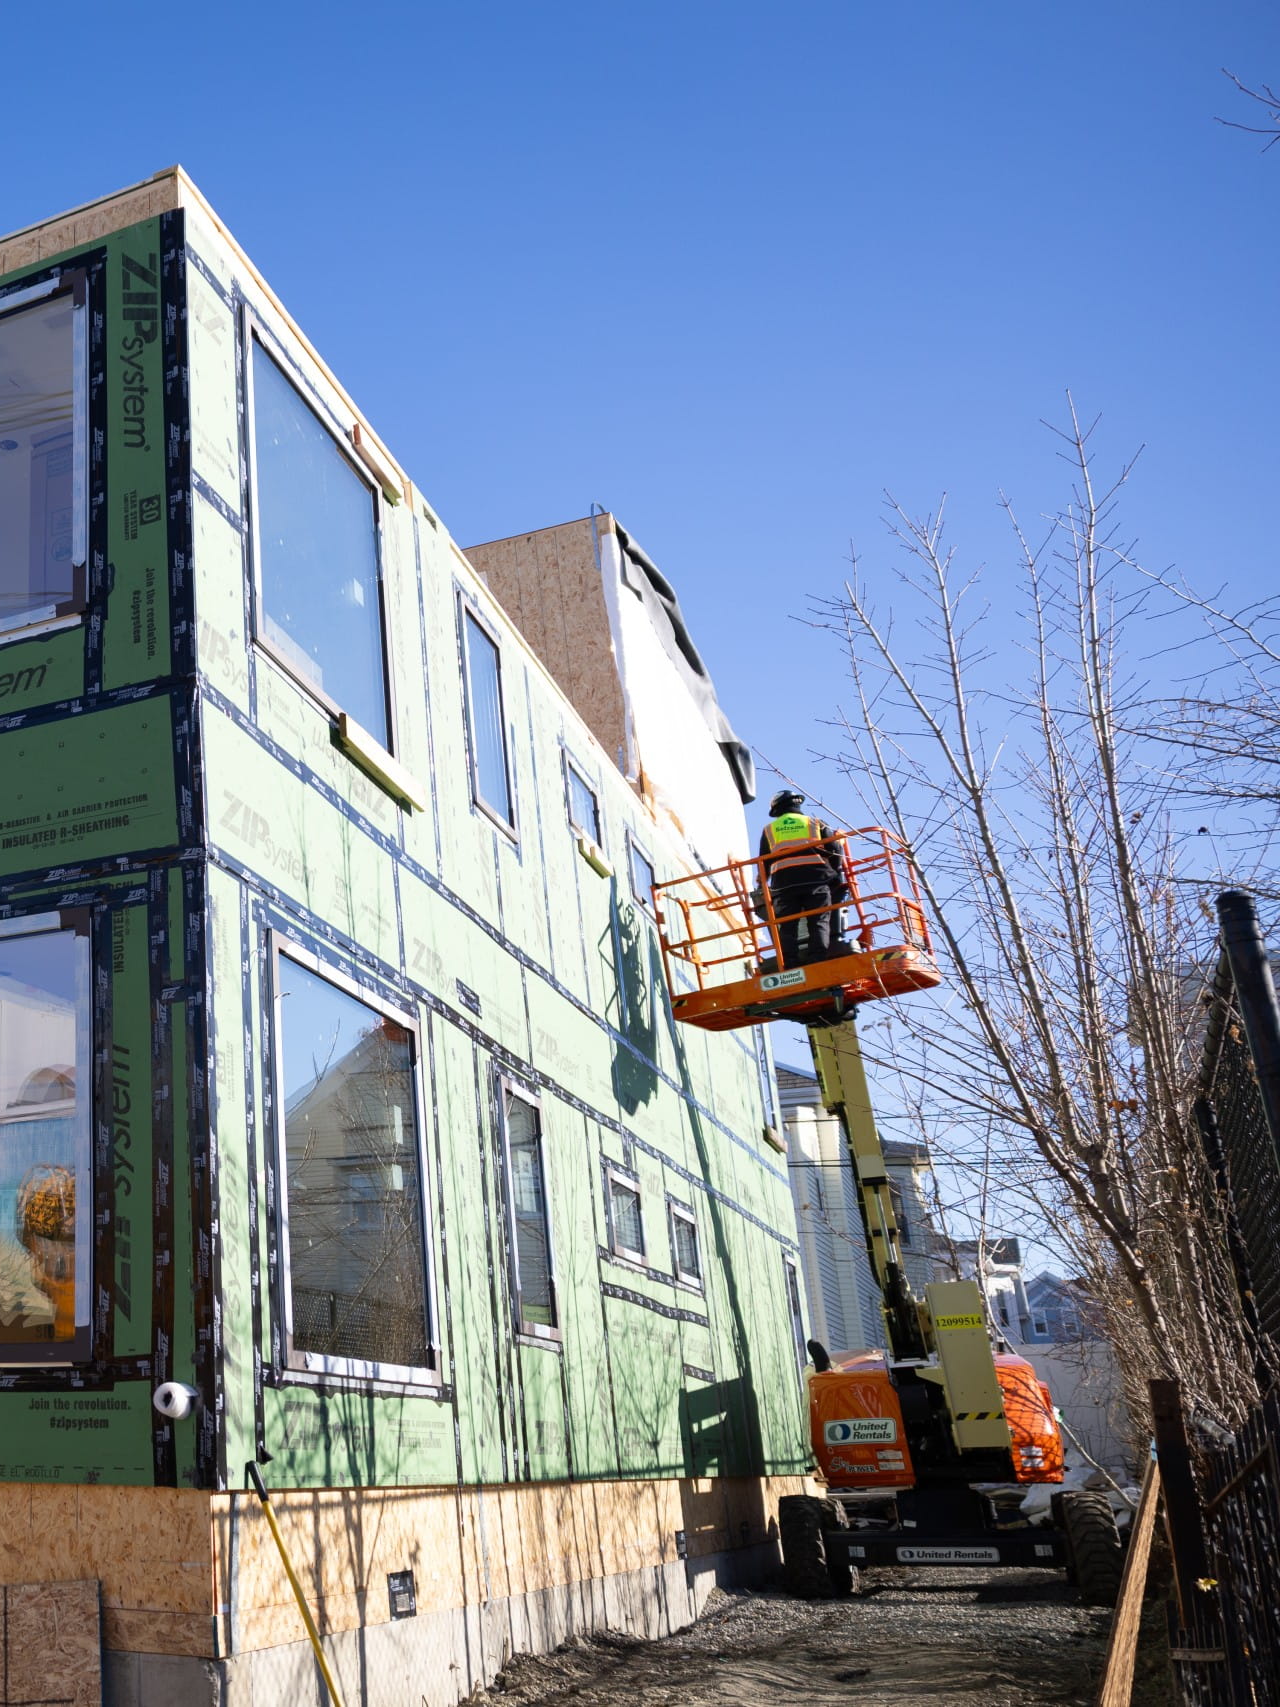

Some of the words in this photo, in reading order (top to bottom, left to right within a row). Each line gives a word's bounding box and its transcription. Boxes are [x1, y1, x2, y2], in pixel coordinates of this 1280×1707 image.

[120, 252, 158, 449] ZIPsystem
[141, 498, 159, 524] 30
[2, 829, 56, 849] INSULATED
[60, 814, 130, 839] R-SHEATHING
[219, 789, 316, 892] ZIPsystem
[780, 970, 801, 980] United
[936, 1316, 982, 1328] 12099514
[29, 1398, 50, 1410] Join
[53, 1398, 70, 1410] the
[73, 1398, 132, 1411] revolution.
[50, 1416, 109, 1431] #zipsystem
[853, 1422, 889, 1431] United
[853, 1431, 892, 1440] Rentals
[916, 1550, 951, 1559] United
[954, 1550, 993, 1559] Rentals
